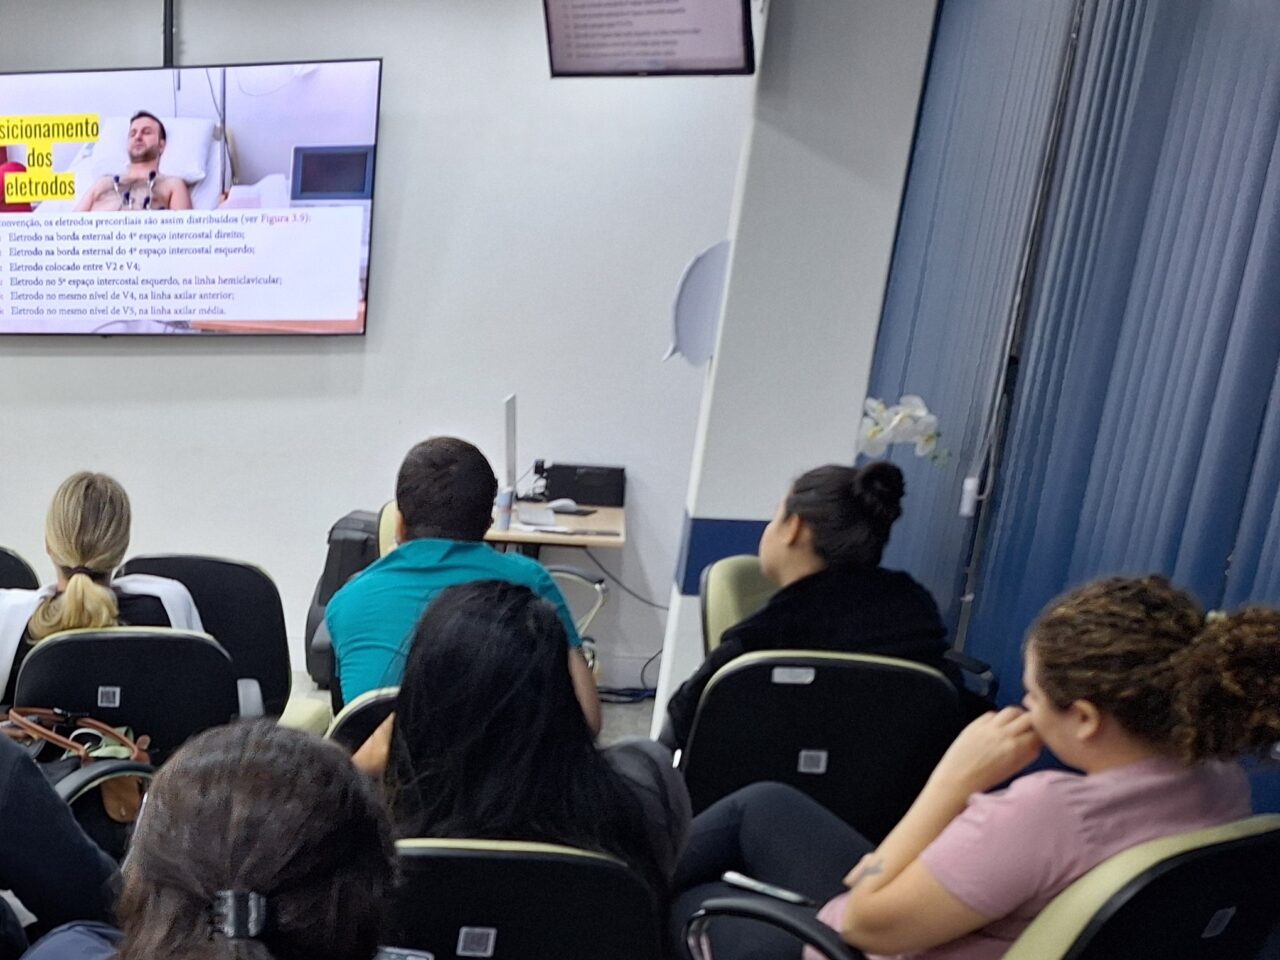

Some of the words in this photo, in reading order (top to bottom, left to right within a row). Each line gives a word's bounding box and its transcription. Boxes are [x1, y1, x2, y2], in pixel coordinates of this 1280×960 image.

[26, 147, 53, 168] dos
[6, 176, 76, 198] eletrodos
[55, 217, 93, 226] eletrodos
[95, 216, 141, 229] precordiais
[144, 216, 158, 225] são
[160, 216, 184, 225] assim
[241, 214, 258, 225] (ver
[261, 213, 289, 225] Figura
[8, 232, 42, 242] Eletrodo
[56, 231, 80, 241] borda
[115, 231, 126, 240] do
[139, 232, 166, 242] espaço
[169, 230, 212, 240] intercostal
[9, 247, 42, 256] Eletrodo
[56, 245, 80, 256] borda
[115, 245, 126, 255] do
[139, 248, 166, 257] espaço
[169, 245, 212, 255] intercostal
[9, 262, 43, 271] Eletrodo
[45, 261, 81, 271] colocado
[83, 263, 103, 271] entre
[105, 262, 117, 271] V2
[10, 277, 43, 286] Eletrodo
[68, 278, 95, 288] espaço
[97, 275, 139, 286] intercostal
[194, 275, 216, 285] linha
[11, 291, 43, 300] Eletrodo
[89, 291, 108, 300] nível
[111, 291, 120, 300] de
[150, 290, 171, 300] linha
[173, 290, 197, 300] axilar
[11, 306, 44, 315] Eletrodo
[89, 305, 109, 315] nível
[111, 306, 120, 315] de
[150, 305, 171, 315] linha
[173, 305, 196, 315] axilar
